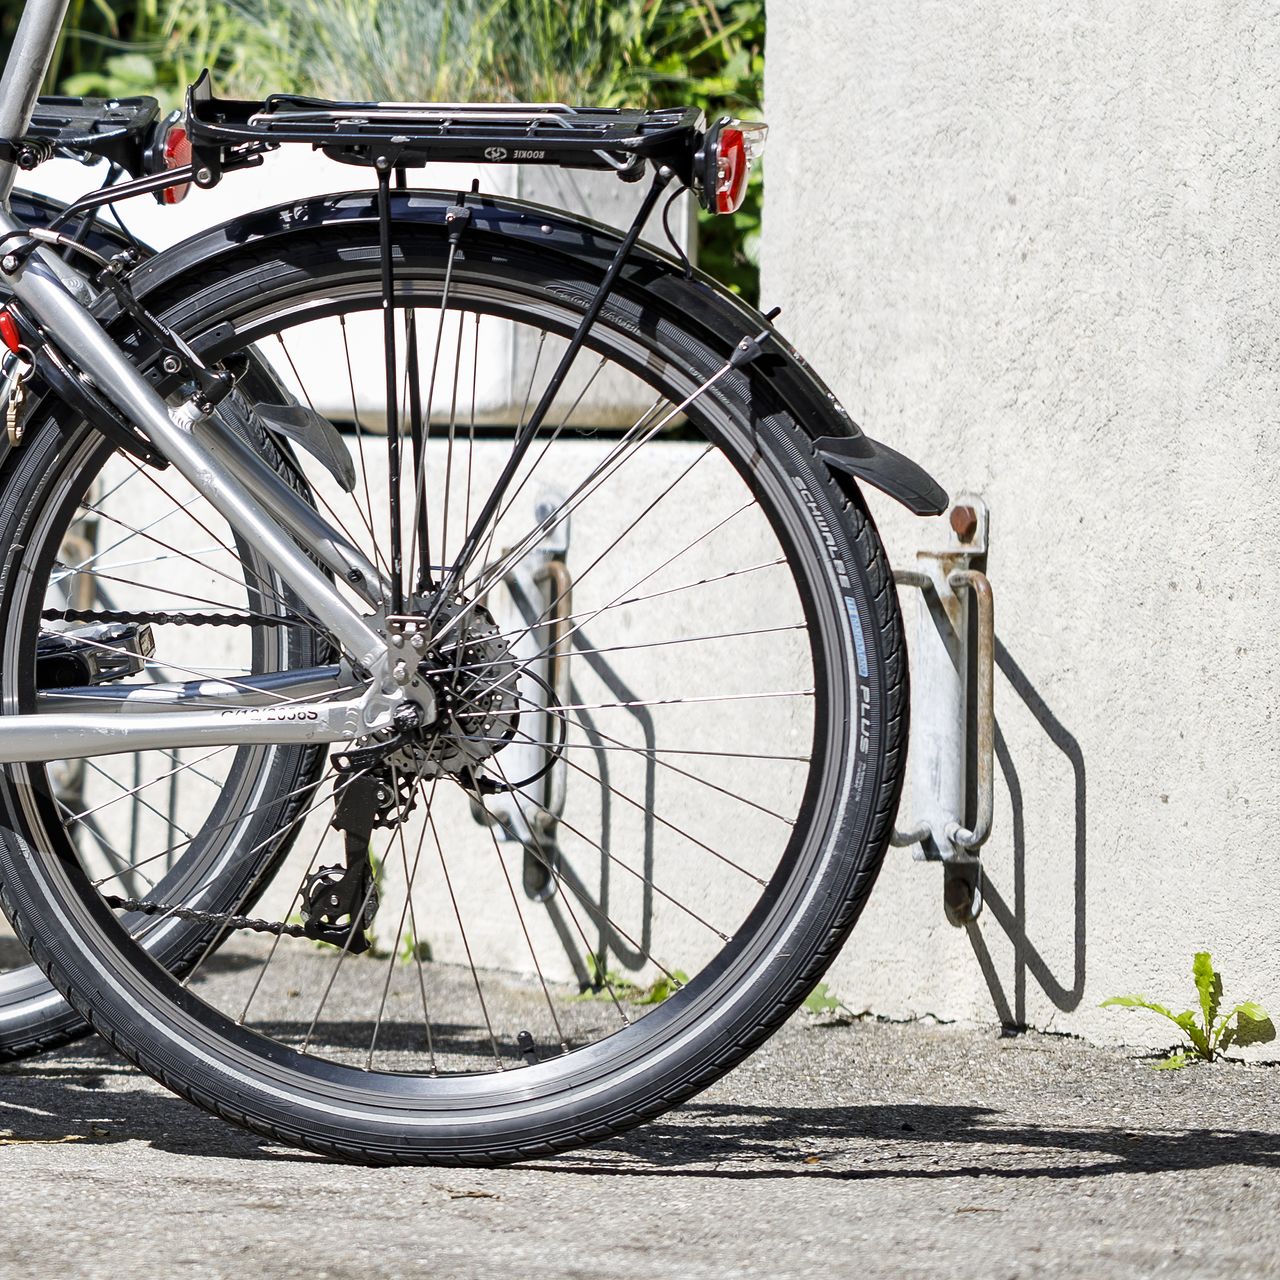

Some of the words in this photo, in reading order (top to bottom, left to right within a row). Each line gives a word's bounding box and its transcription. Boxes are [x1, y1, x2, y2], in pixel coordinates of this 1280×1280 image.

[144, 310, 170, 336] SHIMANO
[791, 475, 851, 589] SCHWALBE
[859, 684, 871, 755] PLUS
